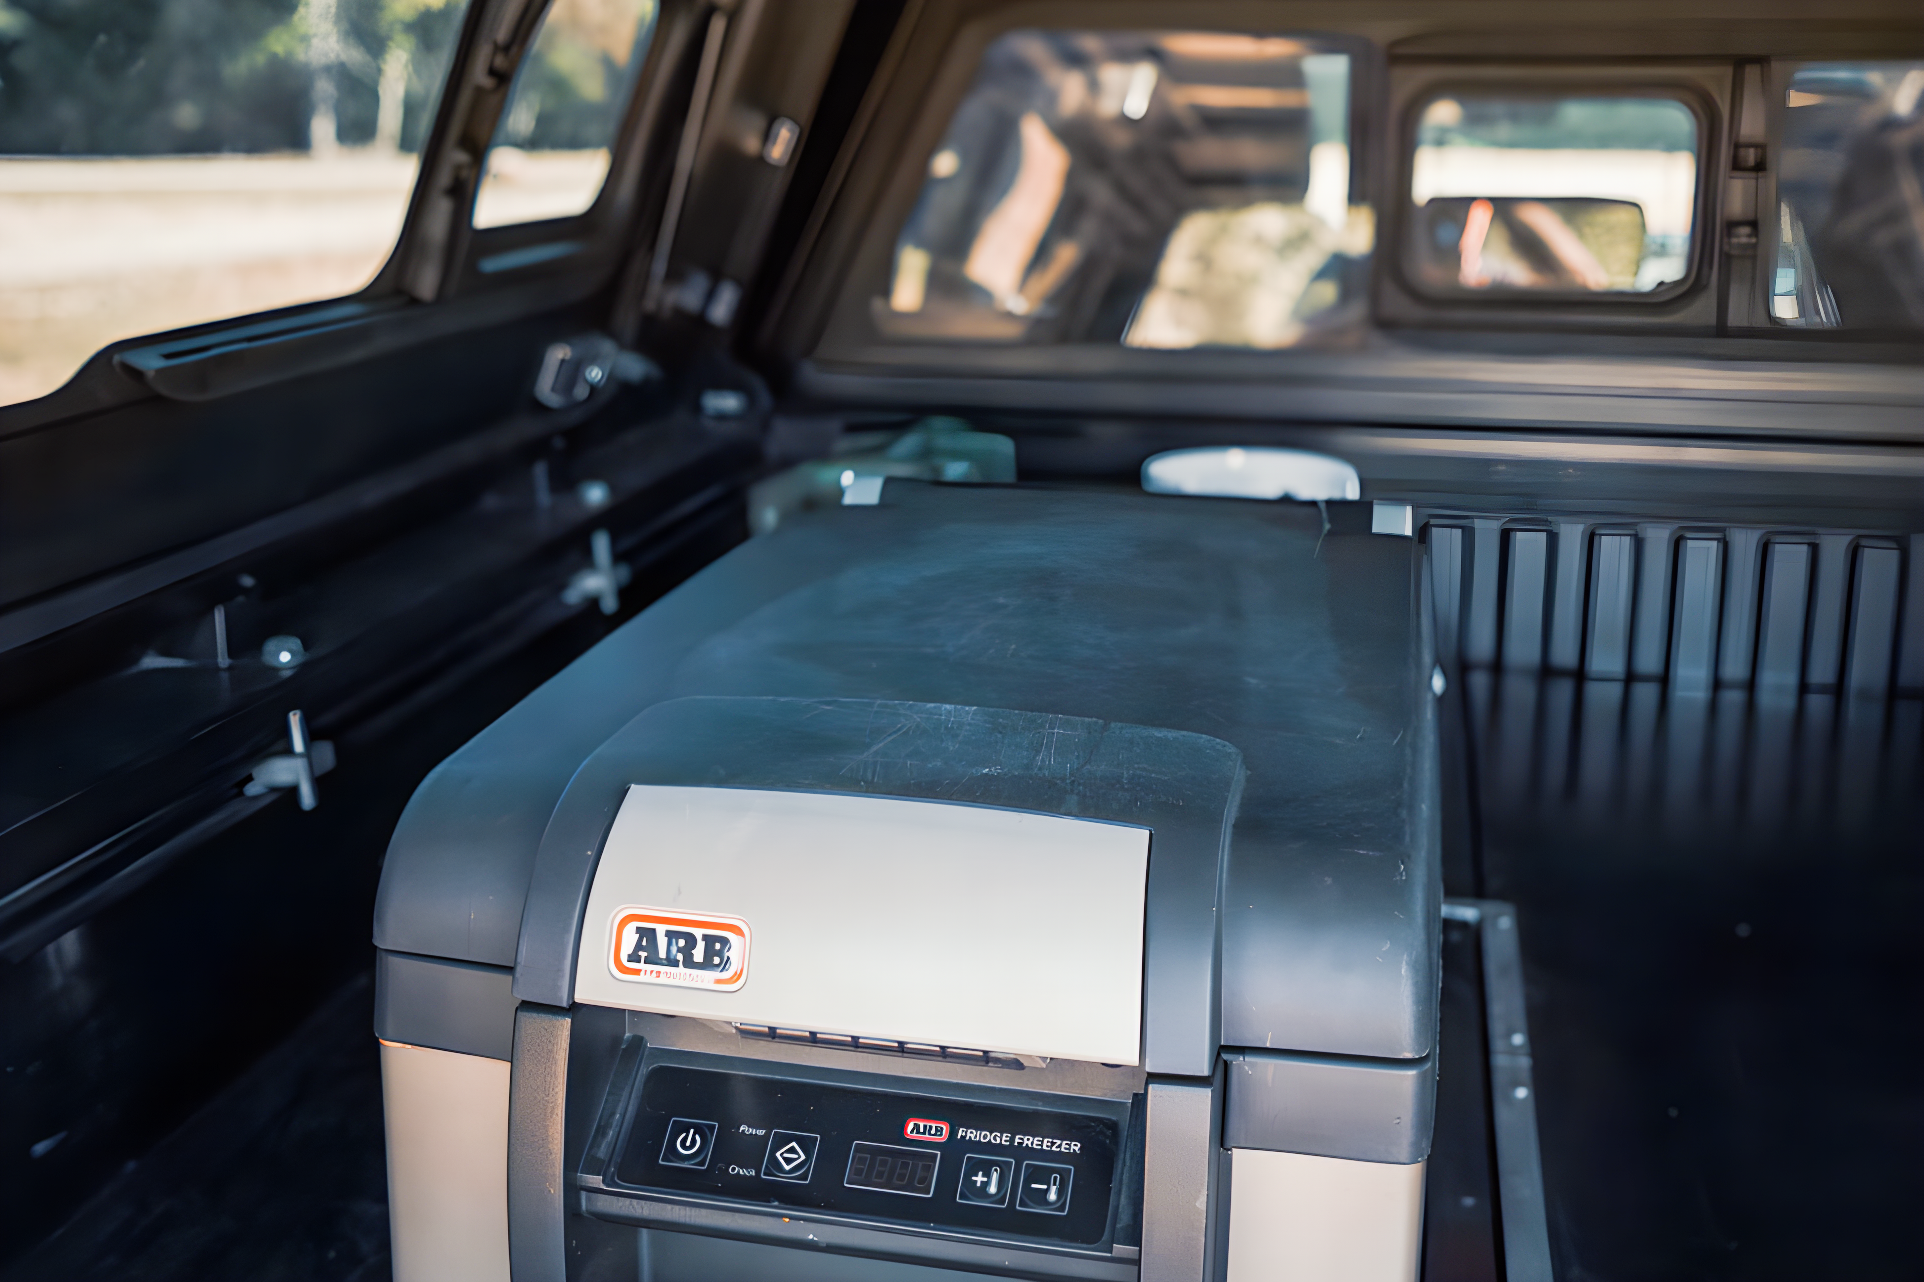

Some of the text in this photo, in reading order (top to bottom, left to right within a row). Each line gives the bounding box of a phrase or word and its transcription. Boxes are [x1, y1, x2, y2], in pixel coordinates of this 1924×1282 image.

[627, 926, 731, 973] ARB
[957, 1128, 1081, 1153] FRIDGE FREEZER
